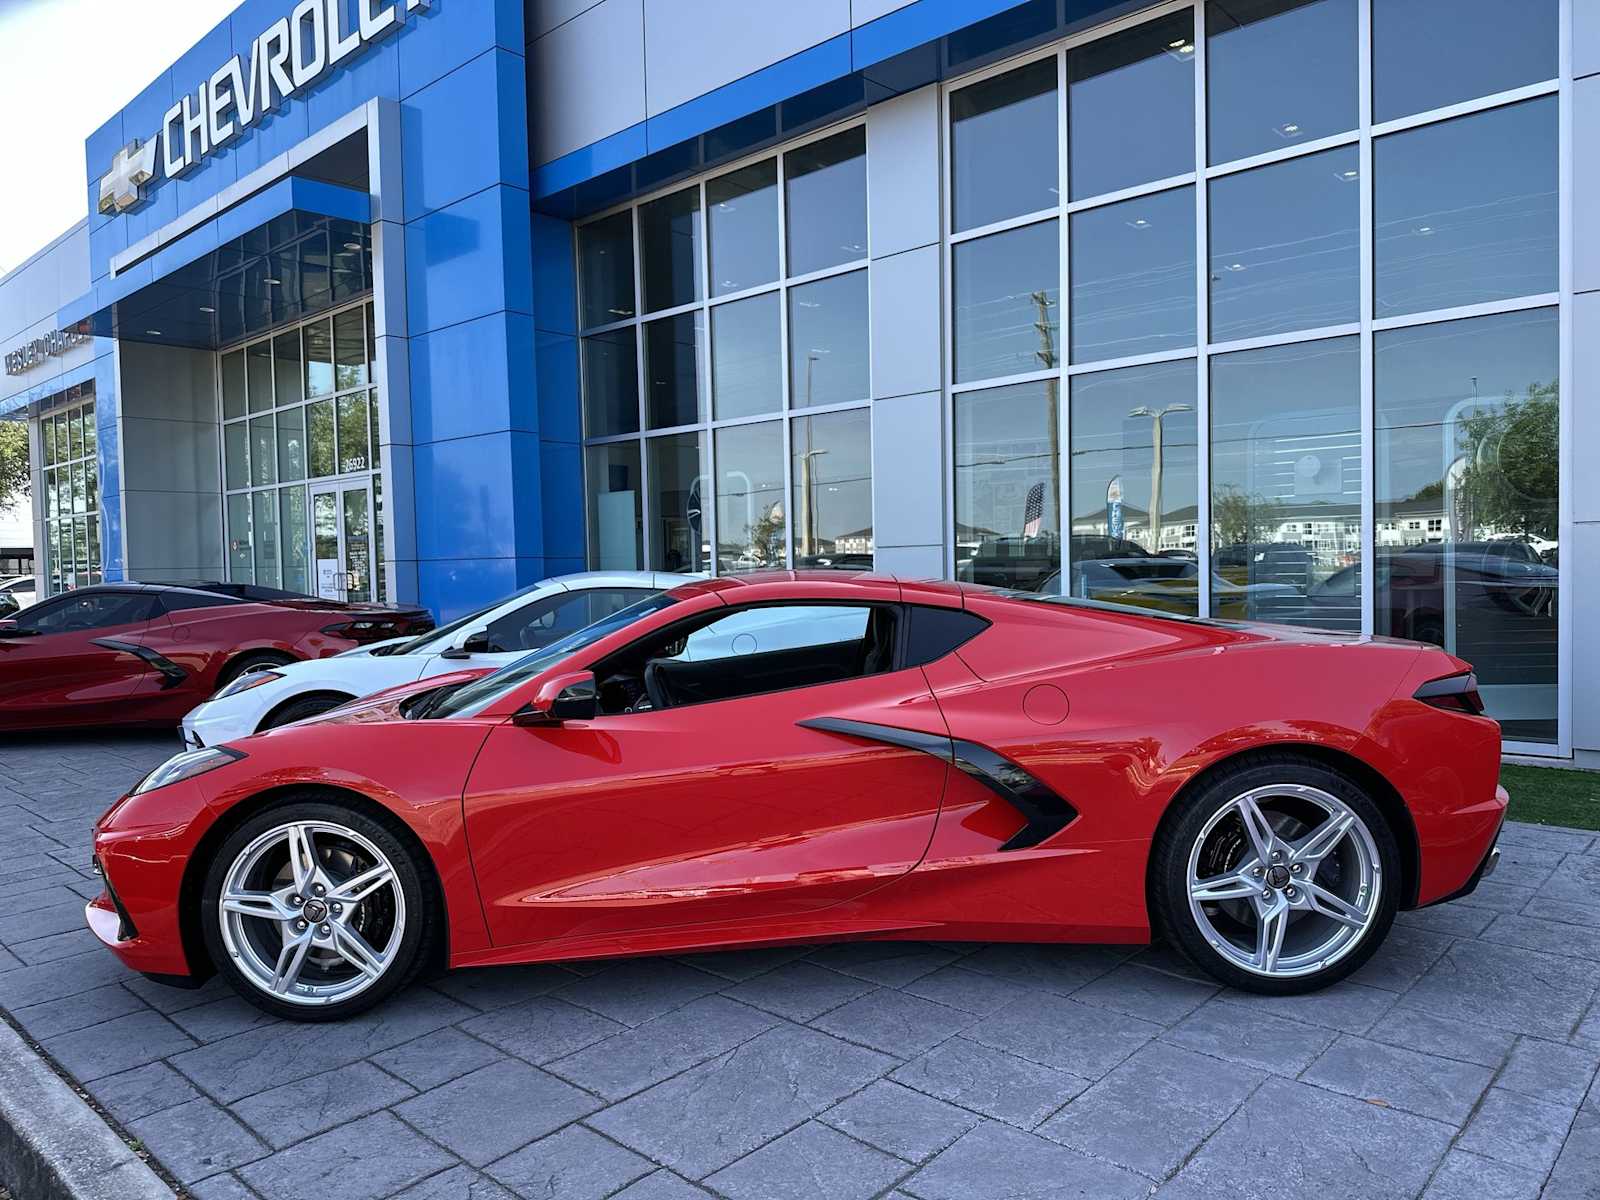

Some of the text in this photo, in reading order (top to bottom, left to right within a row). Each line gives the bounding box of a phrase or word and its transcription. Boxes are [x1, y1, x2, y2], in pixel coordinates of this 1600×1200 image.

[162, 0, 422, 180] CHEVROL
[5, 338, 42, 375] WESLEY
[345, 456, 365, 472] 26922
